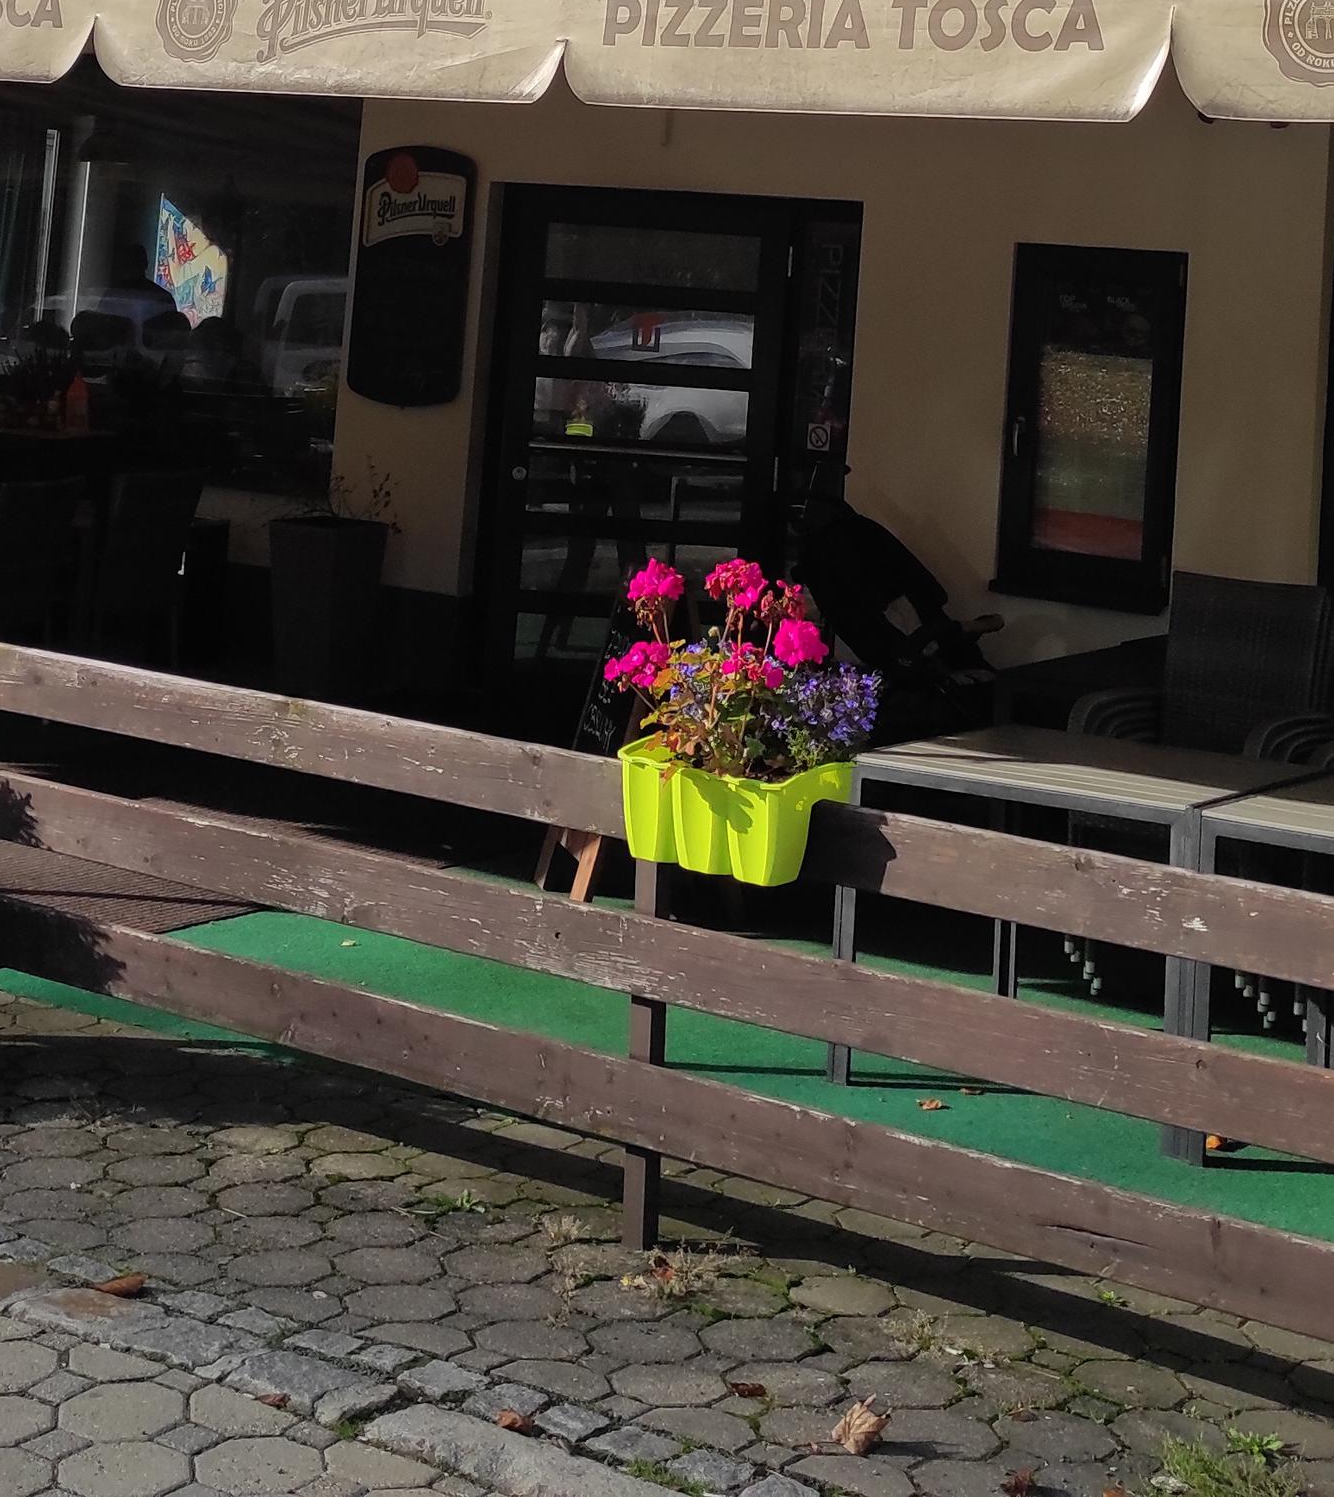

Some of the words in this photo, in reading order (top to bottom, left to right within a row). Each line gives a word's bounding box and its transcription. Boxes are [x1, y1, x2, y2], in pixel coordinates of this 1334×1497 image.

[1291, 41, 1306, 58] OD
[378, 191, 418, 226] Pilsner
[417, 192, 456, 219] Urquell
